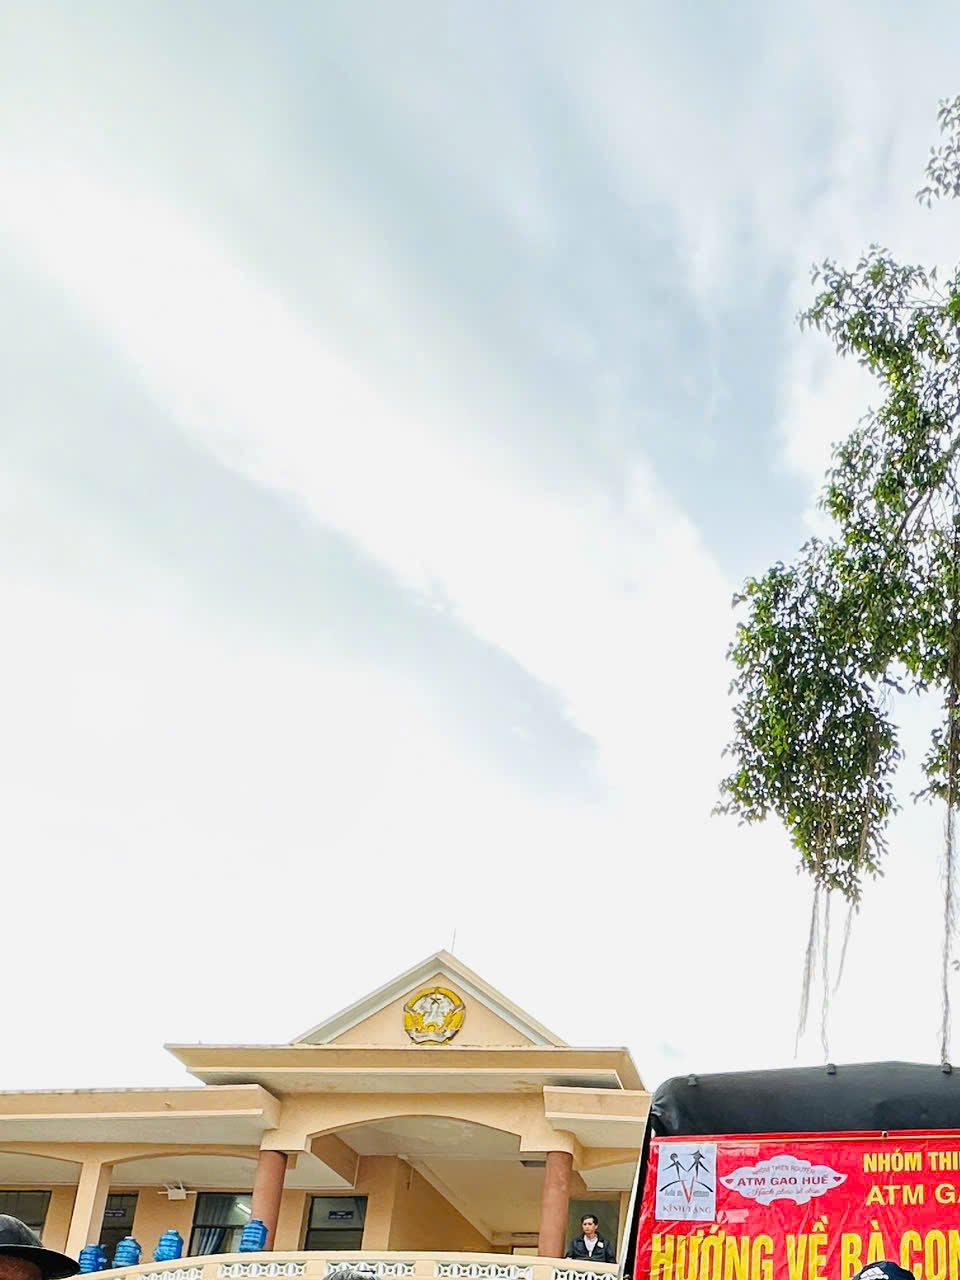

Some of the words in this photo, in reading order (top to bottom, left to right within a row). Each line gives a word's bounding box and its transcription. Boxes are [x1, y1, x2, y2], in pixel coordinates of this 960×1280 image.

[863, 1148, 922, 1173] NHÓM
[737, 1177, 766, 1187] ATM
[802, 1173, 829, 1185] HUẾ
[865, 1183, 924, 1206] ATM
